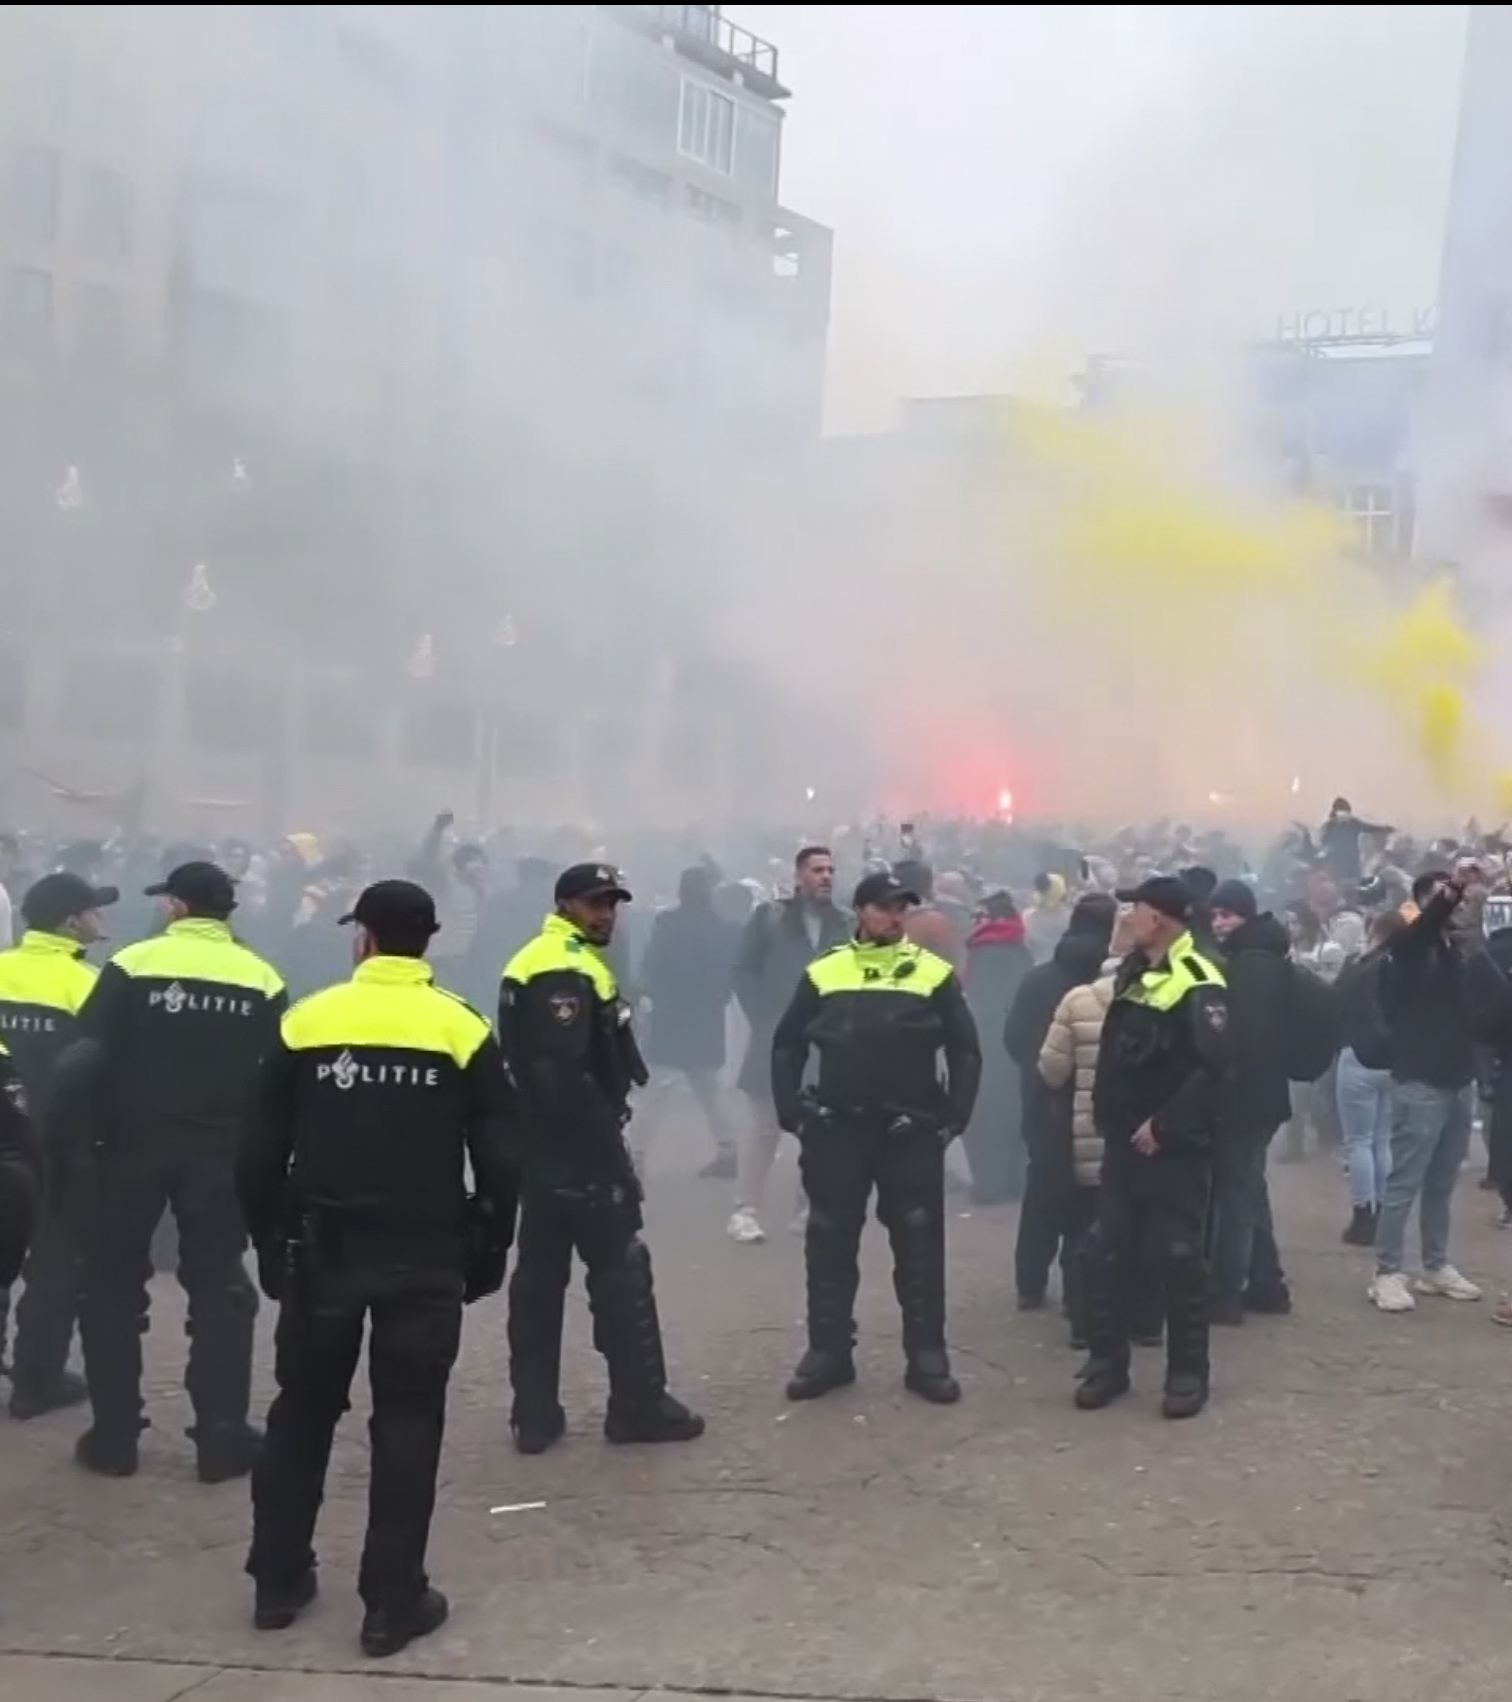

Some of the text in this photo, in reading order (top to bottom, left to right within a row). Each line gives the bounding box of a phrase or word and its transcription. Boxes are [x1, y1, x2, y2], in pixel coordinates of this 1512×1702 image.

[1277, 307, 1391, 340] HOTEL
[0, 1013, 54, 1032] LITIE
[316, 1050, 439, 1089] POLITIE
